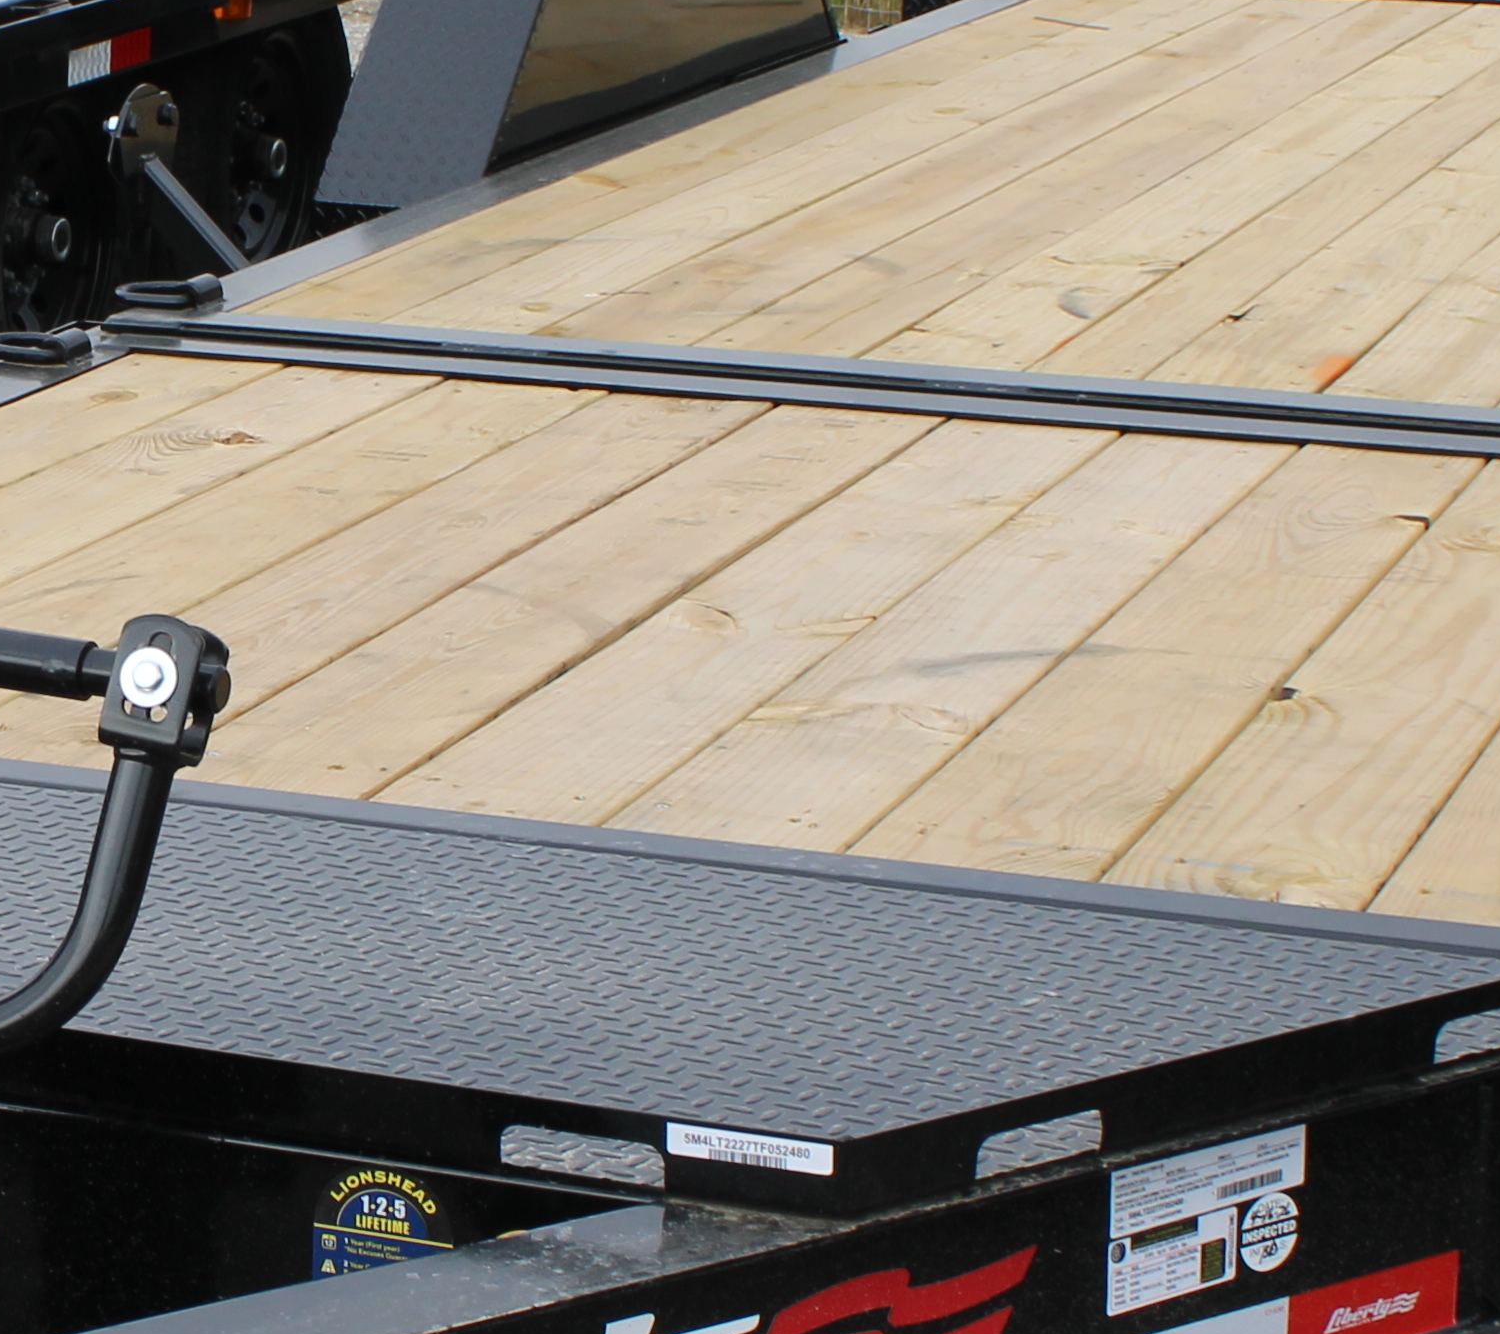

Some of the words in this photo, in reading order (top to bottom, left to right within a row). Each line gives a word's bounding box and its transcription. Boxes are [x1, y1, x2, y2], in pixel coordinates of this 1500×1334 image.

[330, 1170, 437, 1215] LIONSHEAD
[355, 1214, 411, 1235] LIFETIME
[1241, 1218, 1298, 1246] INSPECTED
[1323, 1297, 1394, 1334] Liberty
